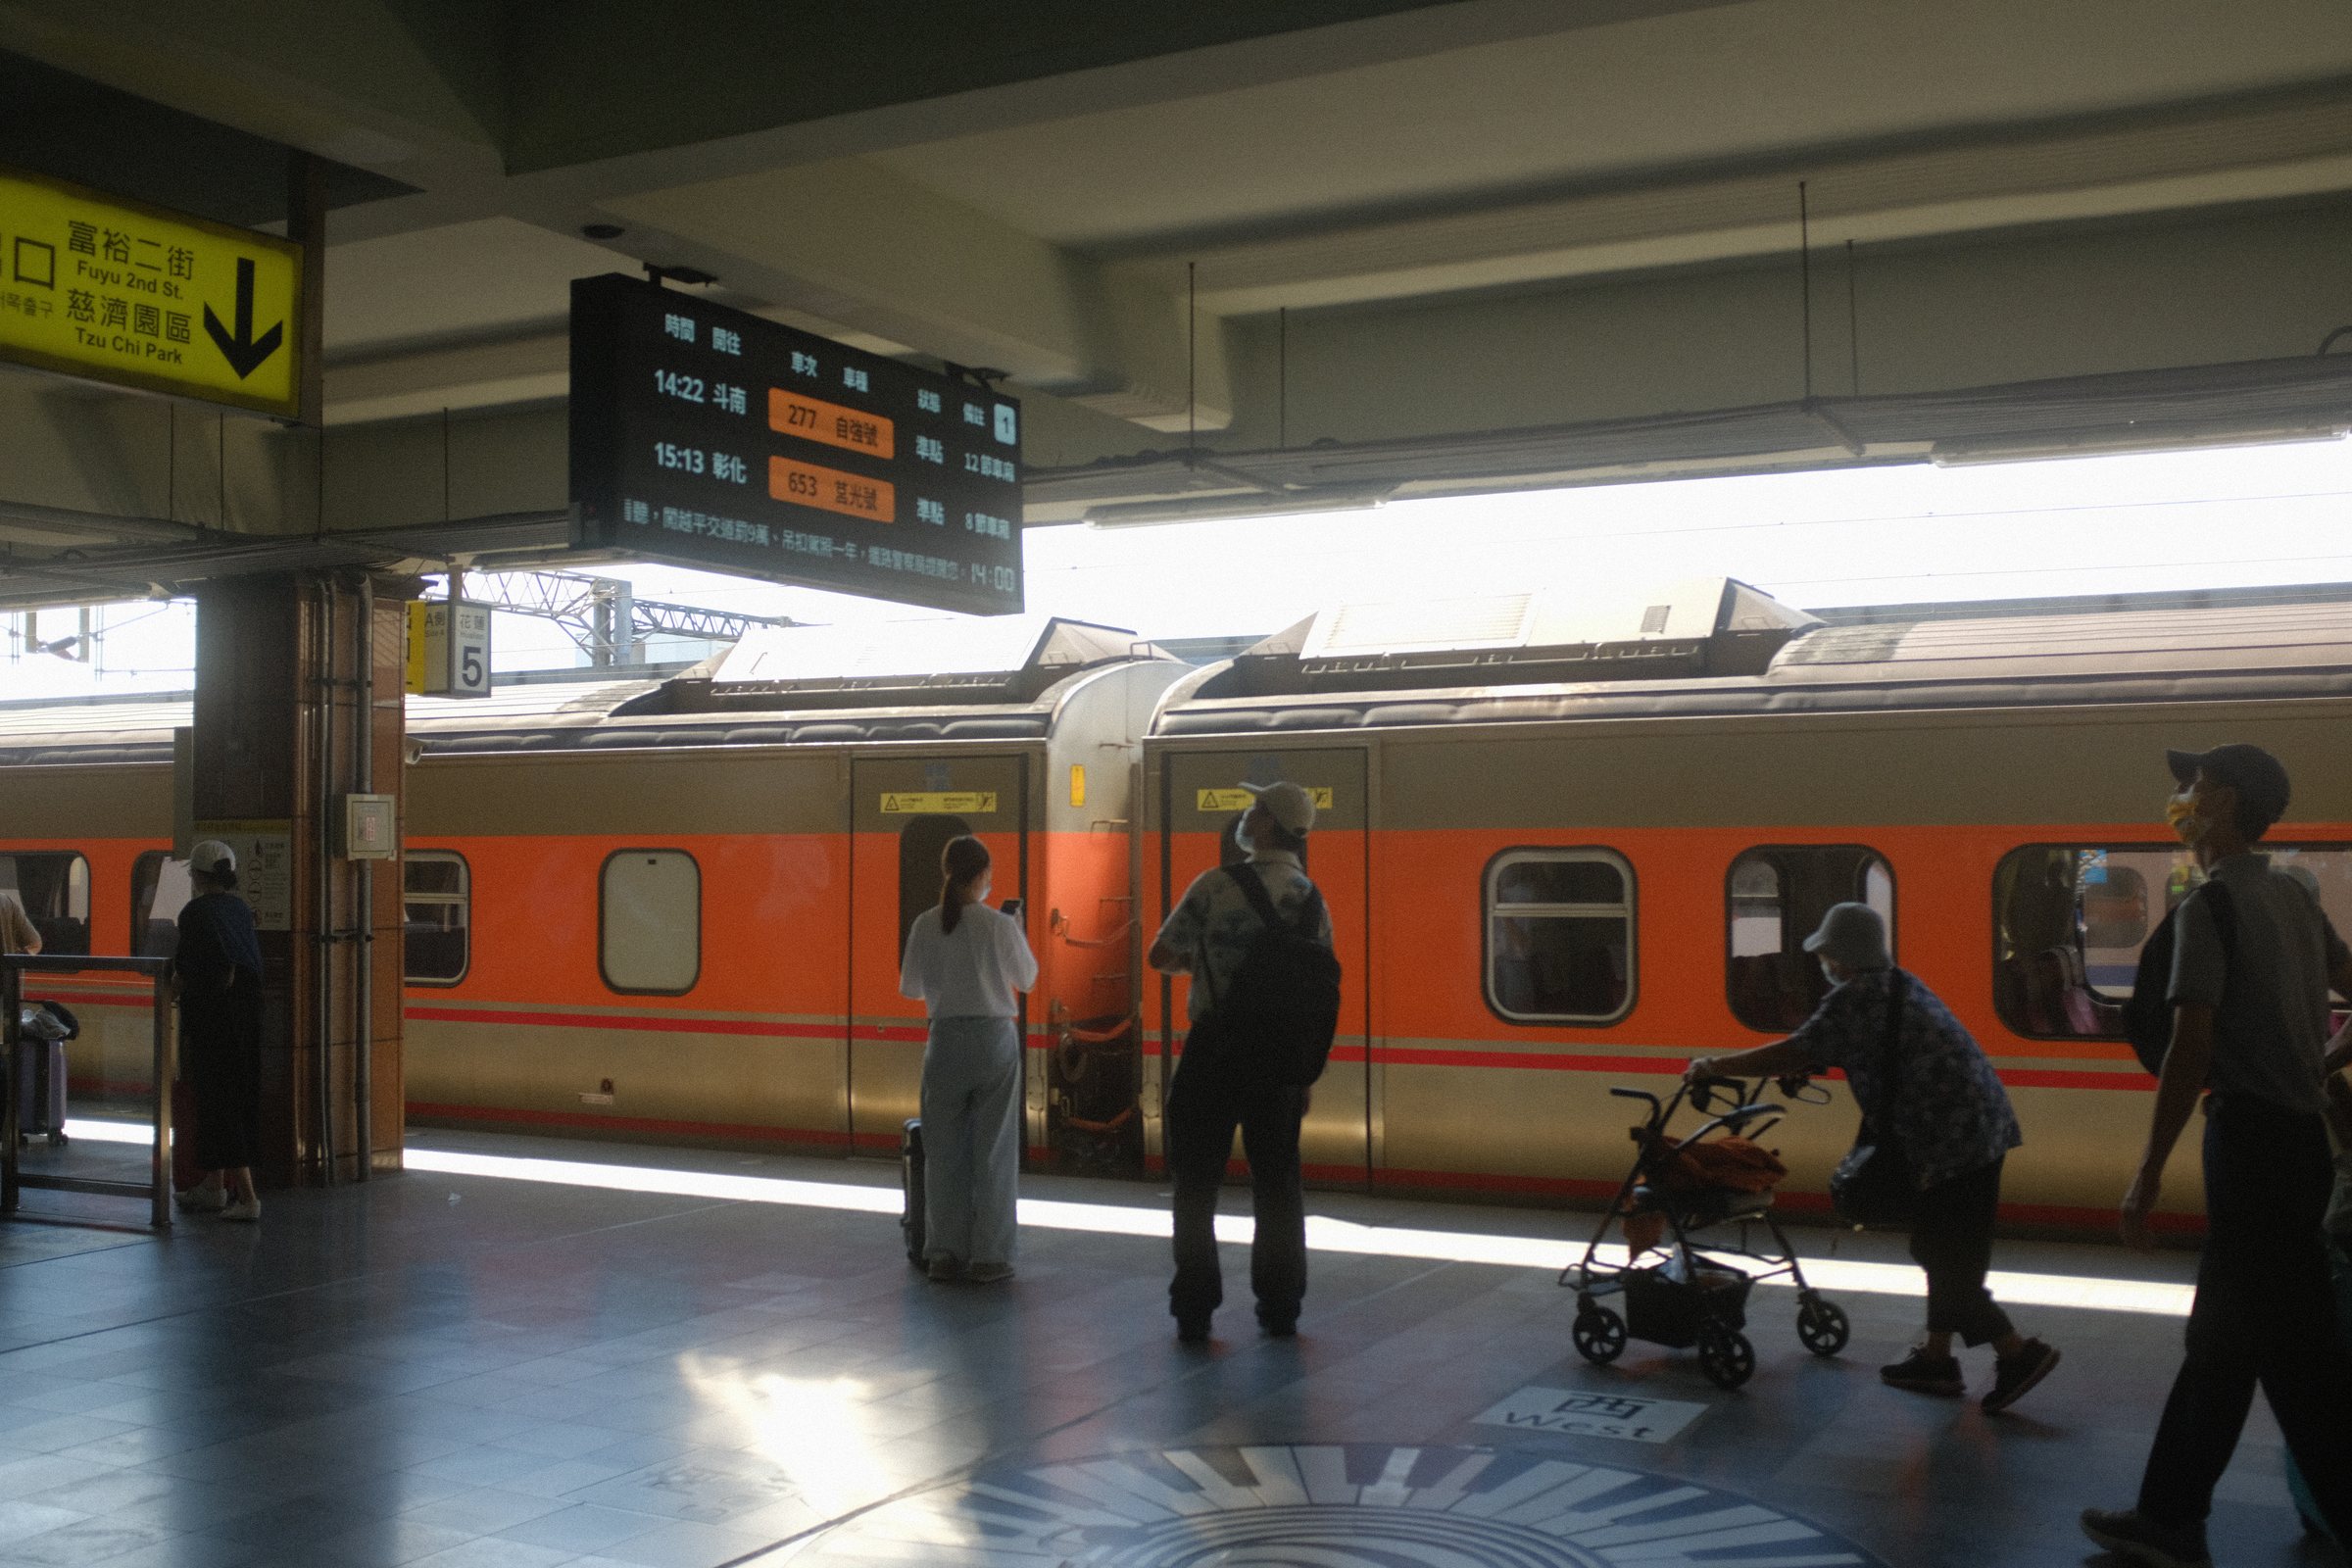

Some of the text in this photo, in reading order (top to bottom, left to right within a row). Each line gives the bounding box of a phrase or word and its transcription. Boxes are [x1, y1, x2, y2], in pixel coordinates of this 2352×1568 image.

[69, 220, 194, 280] 富裕二街
[77, 260, 183, 299] Fuyu 2nd St.
[67, 288, 192, 344] 慈濟園區
[75, 327, 182, 364] Tzu Chi Park
[664, 314, 695, 343] 時間
[712, 326, 742, 356] 開往
[791, 351, 817, 377] 車次
[843, 367, 868, 393] 車種
[654, 368, 705, 403] 14:22
[712, 383, 747, 415] 斗南
[789, 404, 816, 428] 277
[836, 416, 878, 447] 自強號
[915, 435, 944, 465] 準點
[654, 442, 705, 474] 15:13
[712, 452, 747, 484] 彰化
[789, 471, 816, 496] 653
[835, 480, 877, 512] 莒光號
[916, 498, 945, 525] 準點
[970, 563, 1015, 592] 14:00
[460, 614, 485, 631] 花蓮
[462, 646, 482, 687] 5
[1505, 1410, 1655, 1438] West
[1553, 1394, 1656, 1419] 西
